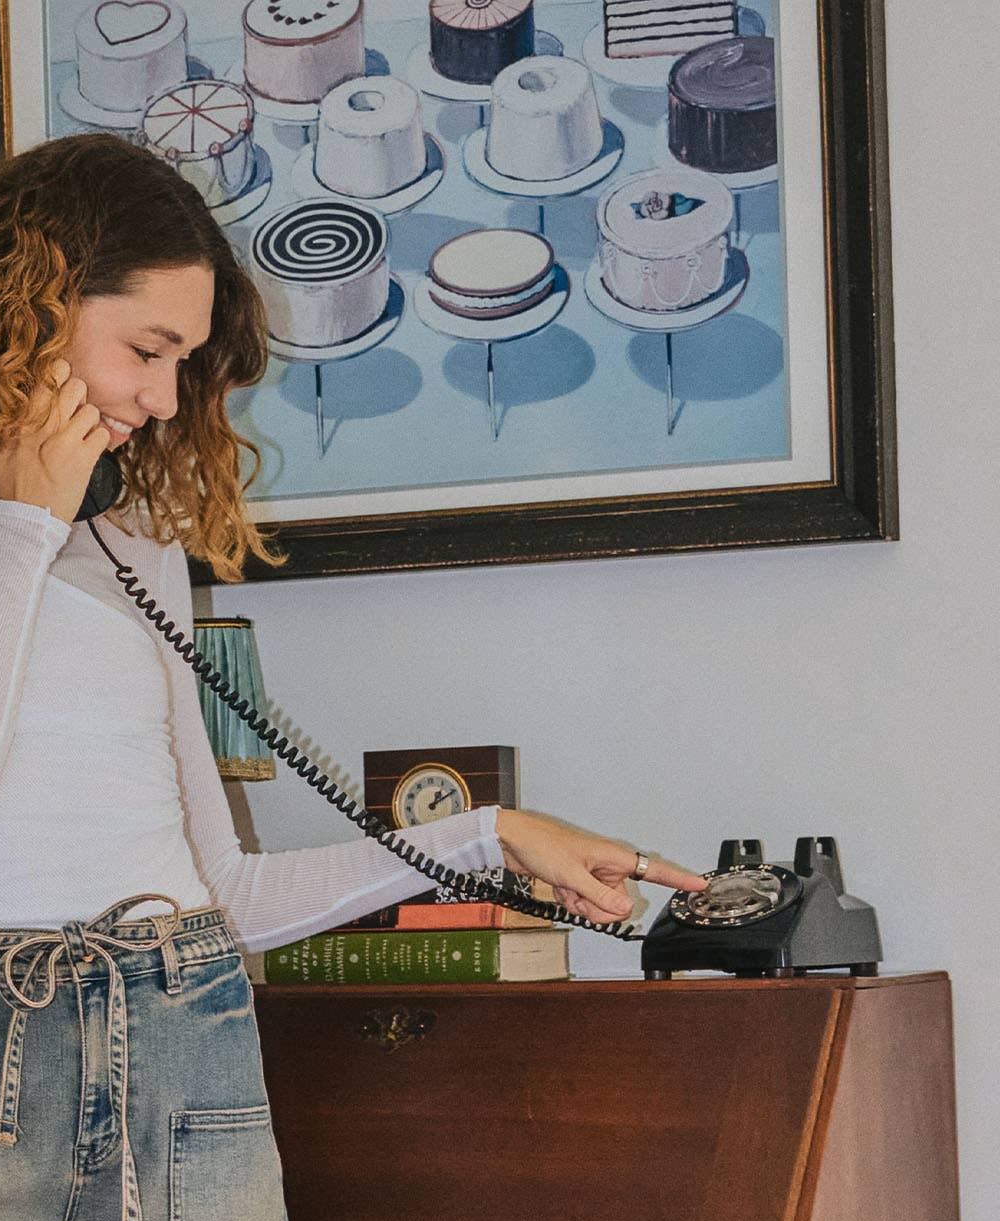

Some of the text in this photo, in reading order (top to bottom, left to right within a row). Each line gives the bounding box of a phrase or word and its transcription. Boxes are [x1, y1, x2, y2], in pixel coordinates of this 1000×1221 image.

[312, 952, 318, 967] OF
[324, 937, 334, 982] DASHIELL
[336, 935, 346, 983] HAMMETT
